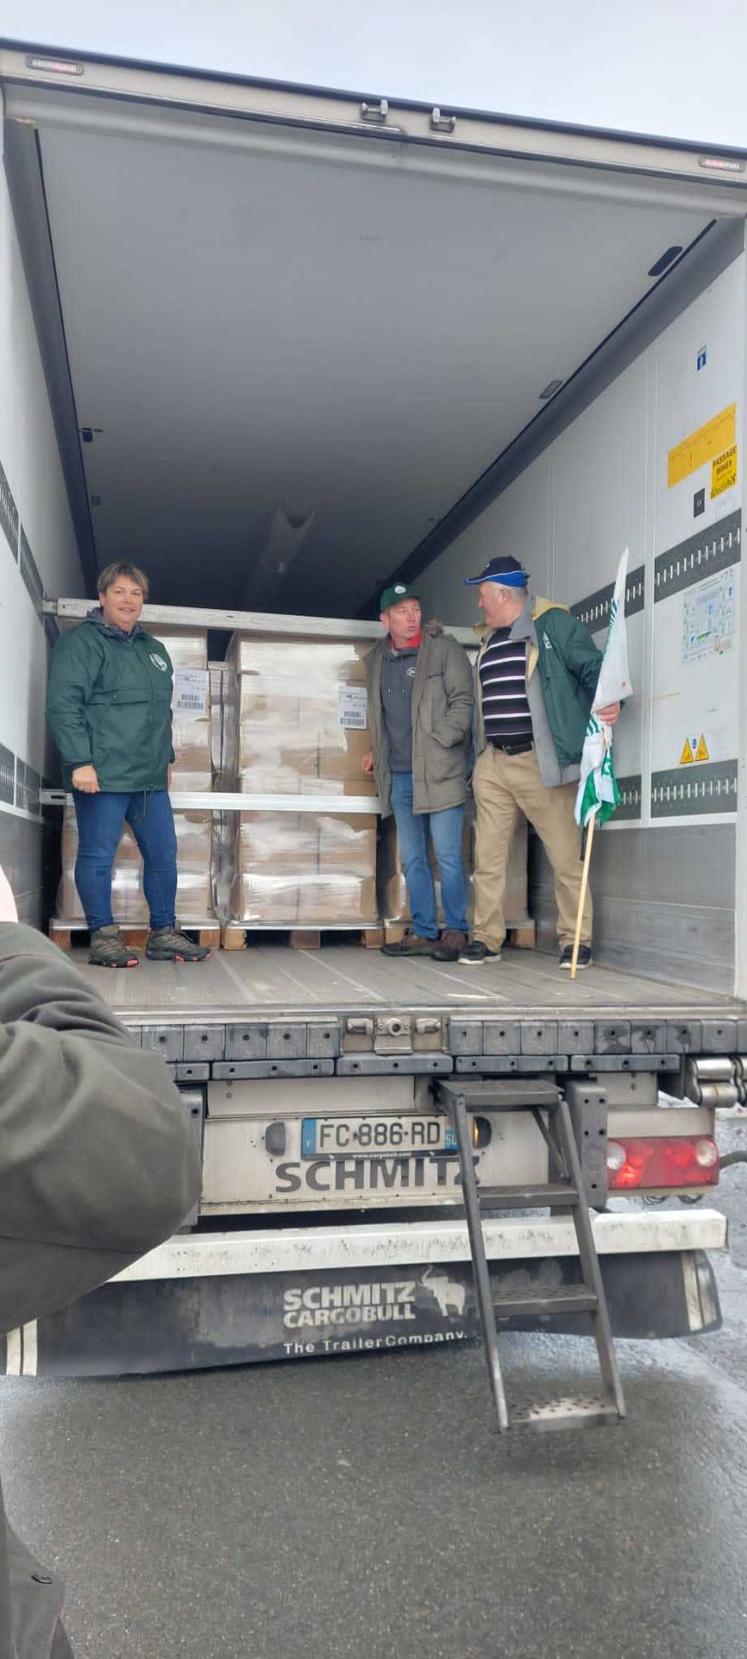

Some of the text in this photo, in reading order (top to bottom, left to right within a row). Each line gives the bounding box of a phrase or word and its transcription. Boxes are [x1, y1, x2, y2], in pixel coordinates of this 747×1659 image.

[283, 1281, 416, 1311] SCHMITZ
[283, 1303, 416, 1328] CARGOBULL
[283, 1342, 315, 1354] The
